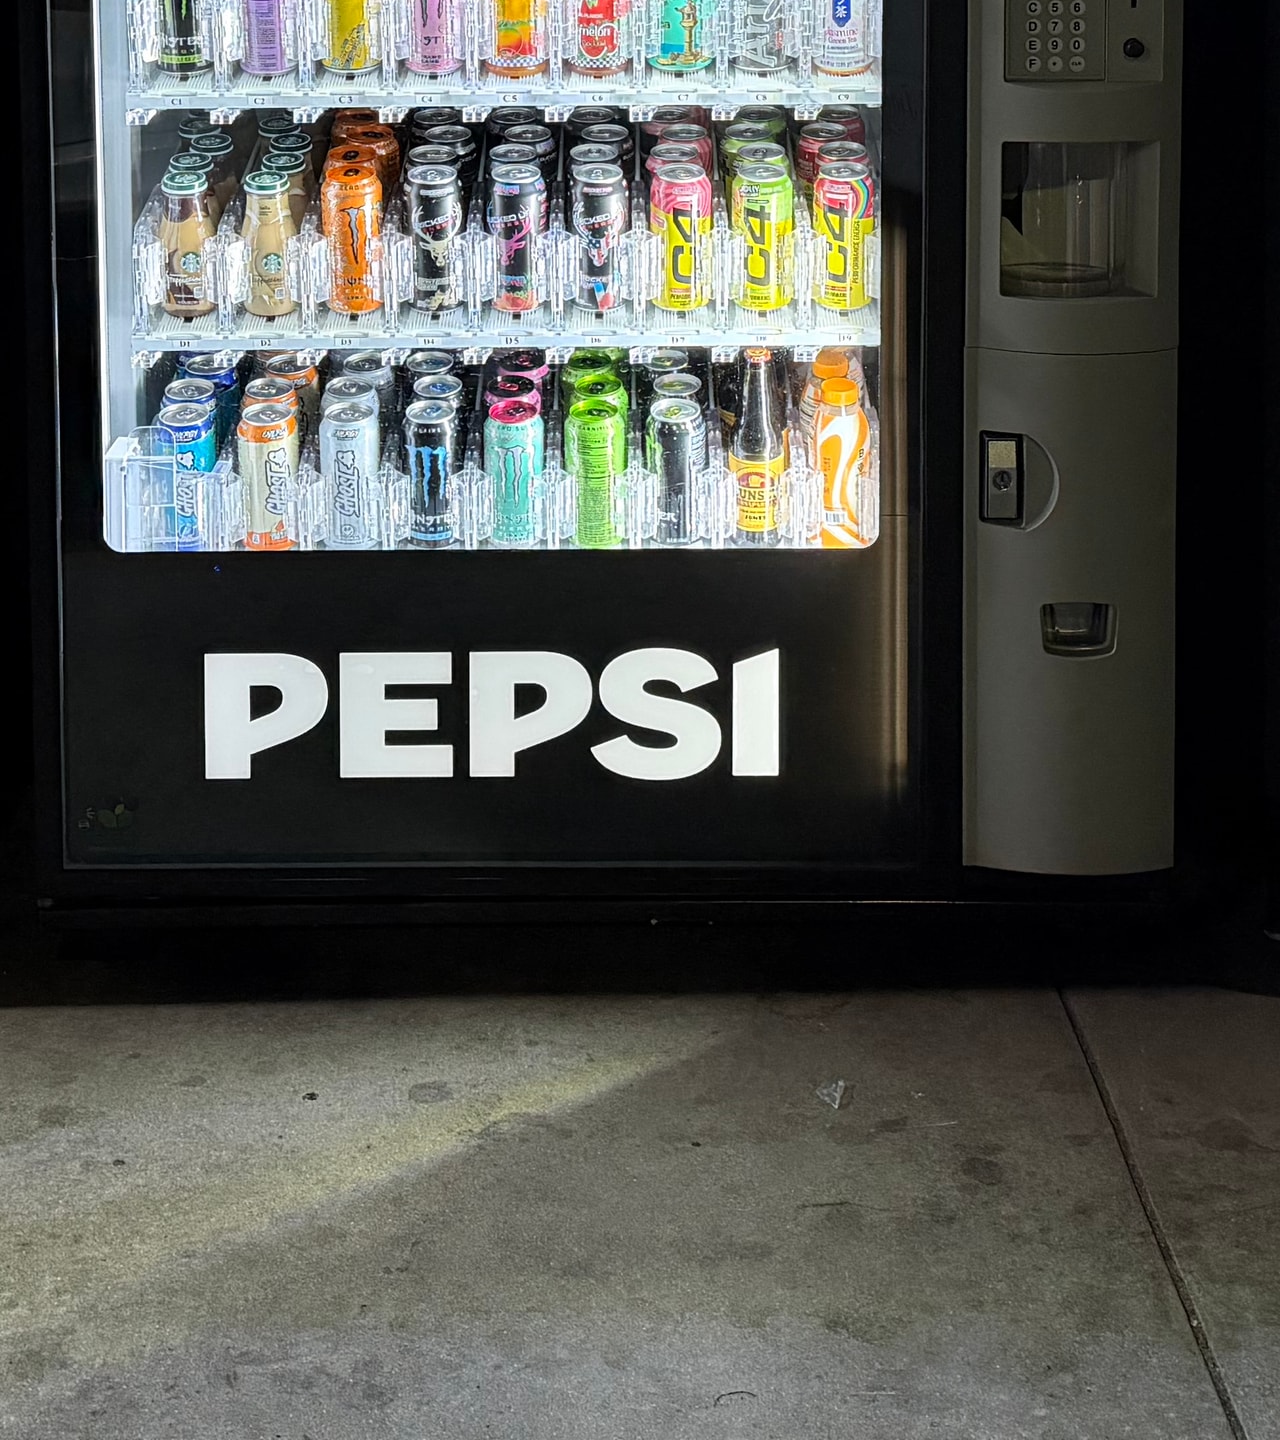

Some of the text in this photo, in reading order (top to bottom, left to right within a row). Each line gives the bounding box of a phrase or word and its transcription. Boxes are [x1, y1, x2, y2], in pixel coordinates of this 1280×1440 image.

[671, 208, 699, 285] C4
[744, 206, 772, 286] C4
[823, 204, 848, 284] C4
[265, 462, 290, 515] GHOST
[335, 462, 360, 518] GHOST
[204, 647, 780, 780] PEPSI
